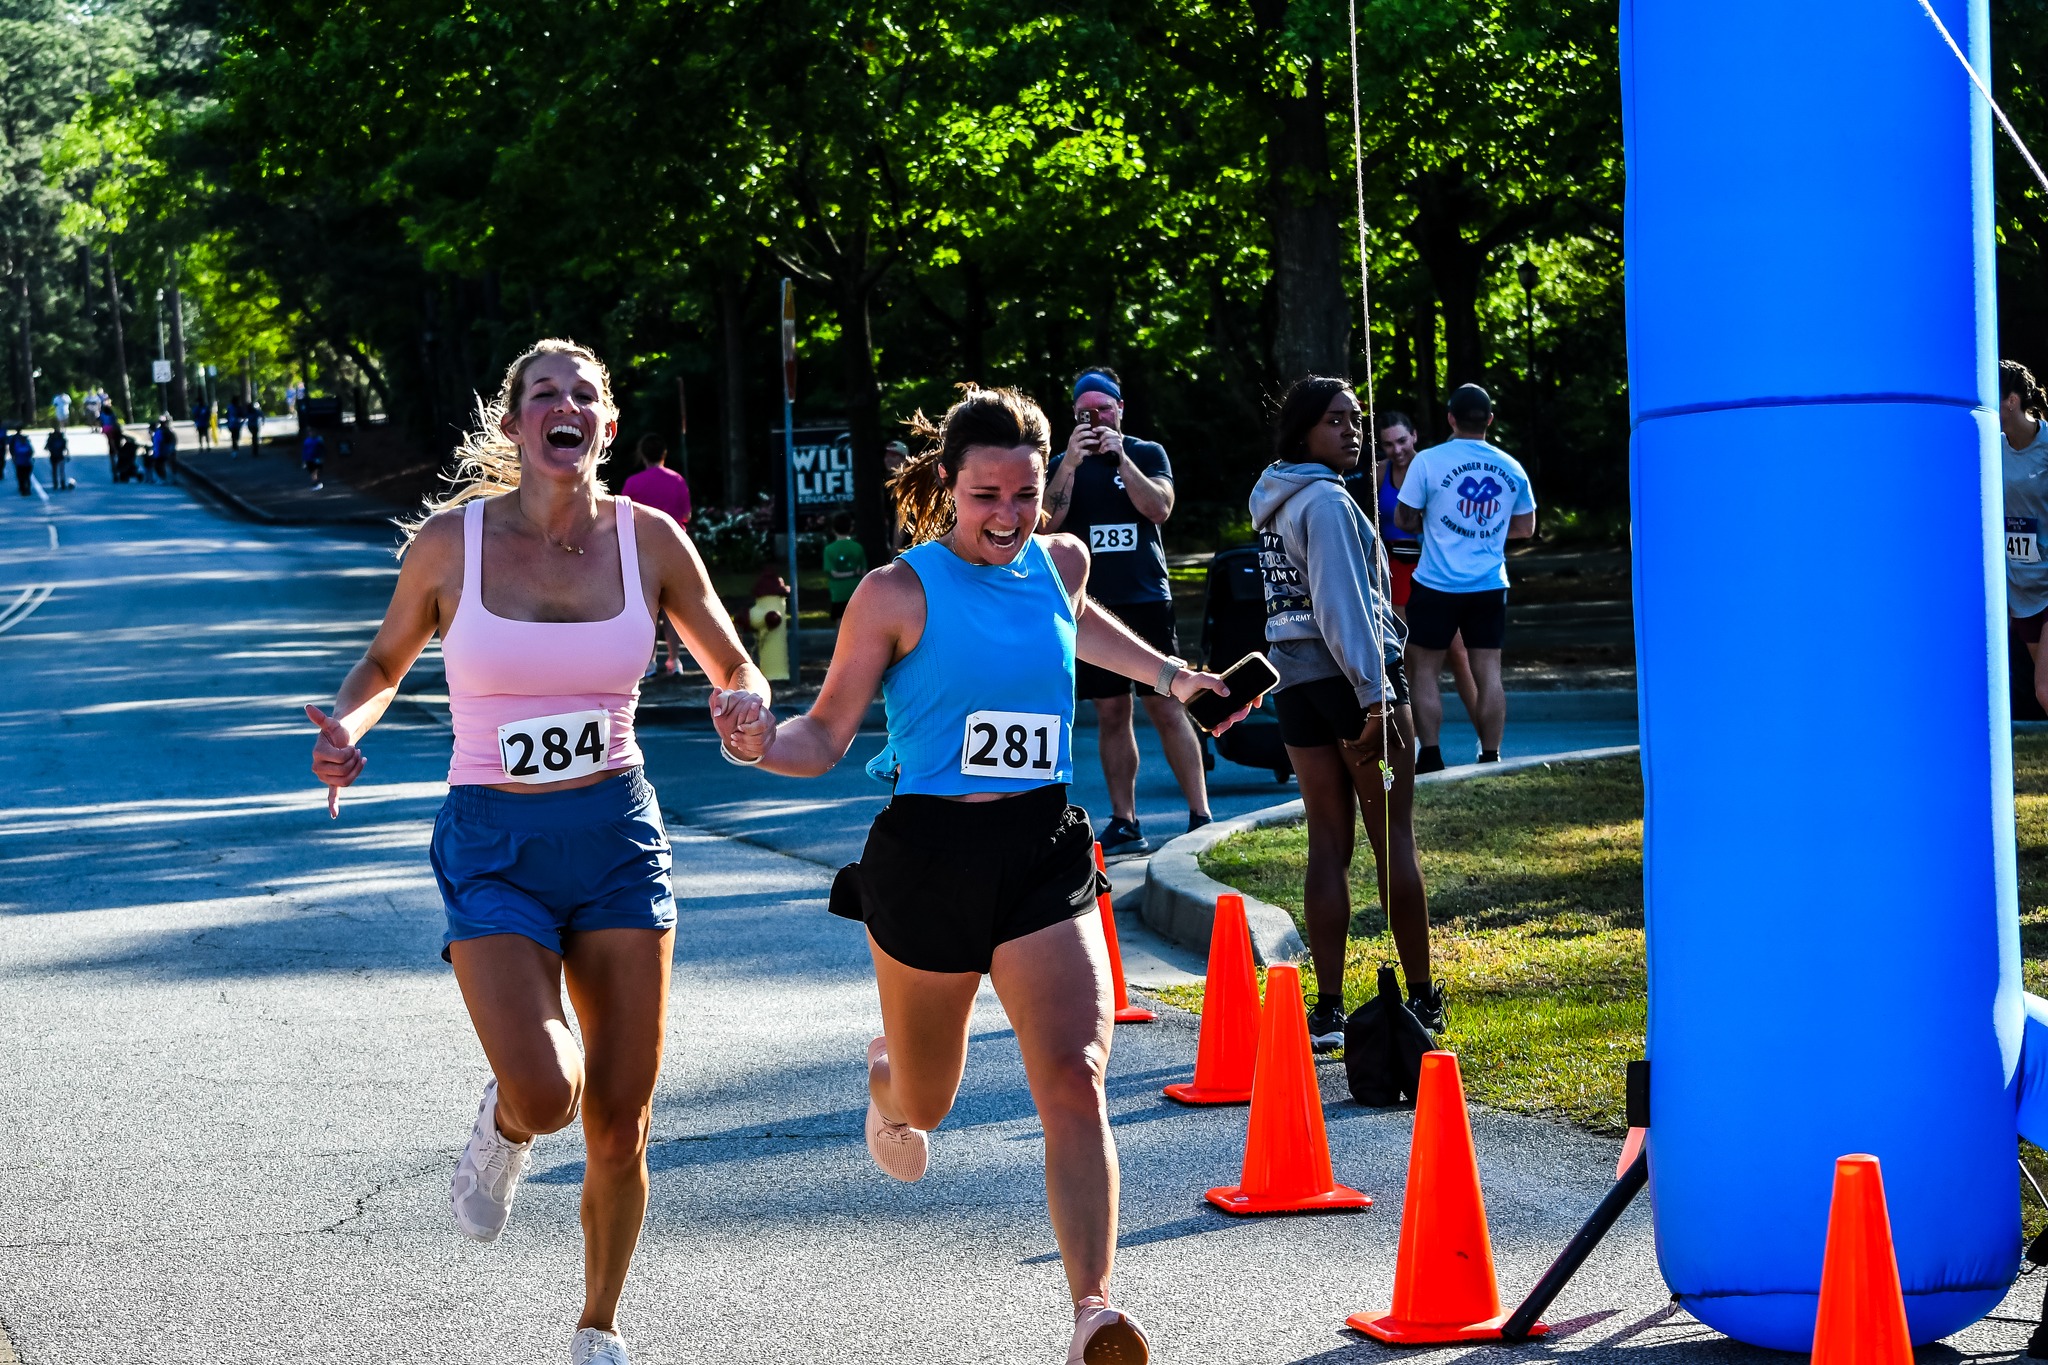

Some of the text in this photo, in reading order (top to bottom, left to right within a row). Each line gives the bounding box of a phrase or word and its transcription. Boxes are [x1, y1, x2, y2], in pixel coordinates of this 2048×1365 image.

[1452, 462, 1482, 477] RANGER
[1484, 463, 1517, 492] BATTALION
[798, 493, 854, 505] EDUCATIO
[1440, 515, 1476, 539] SAVANNAH
[1093, 529, 1134, 548] 283
[2007, 537, 2029, 556] 417
[1289, 613, 1311, 622] ARMY
[506, 721, 604, 776] 284
[969, 723, 1051, 769] 281
